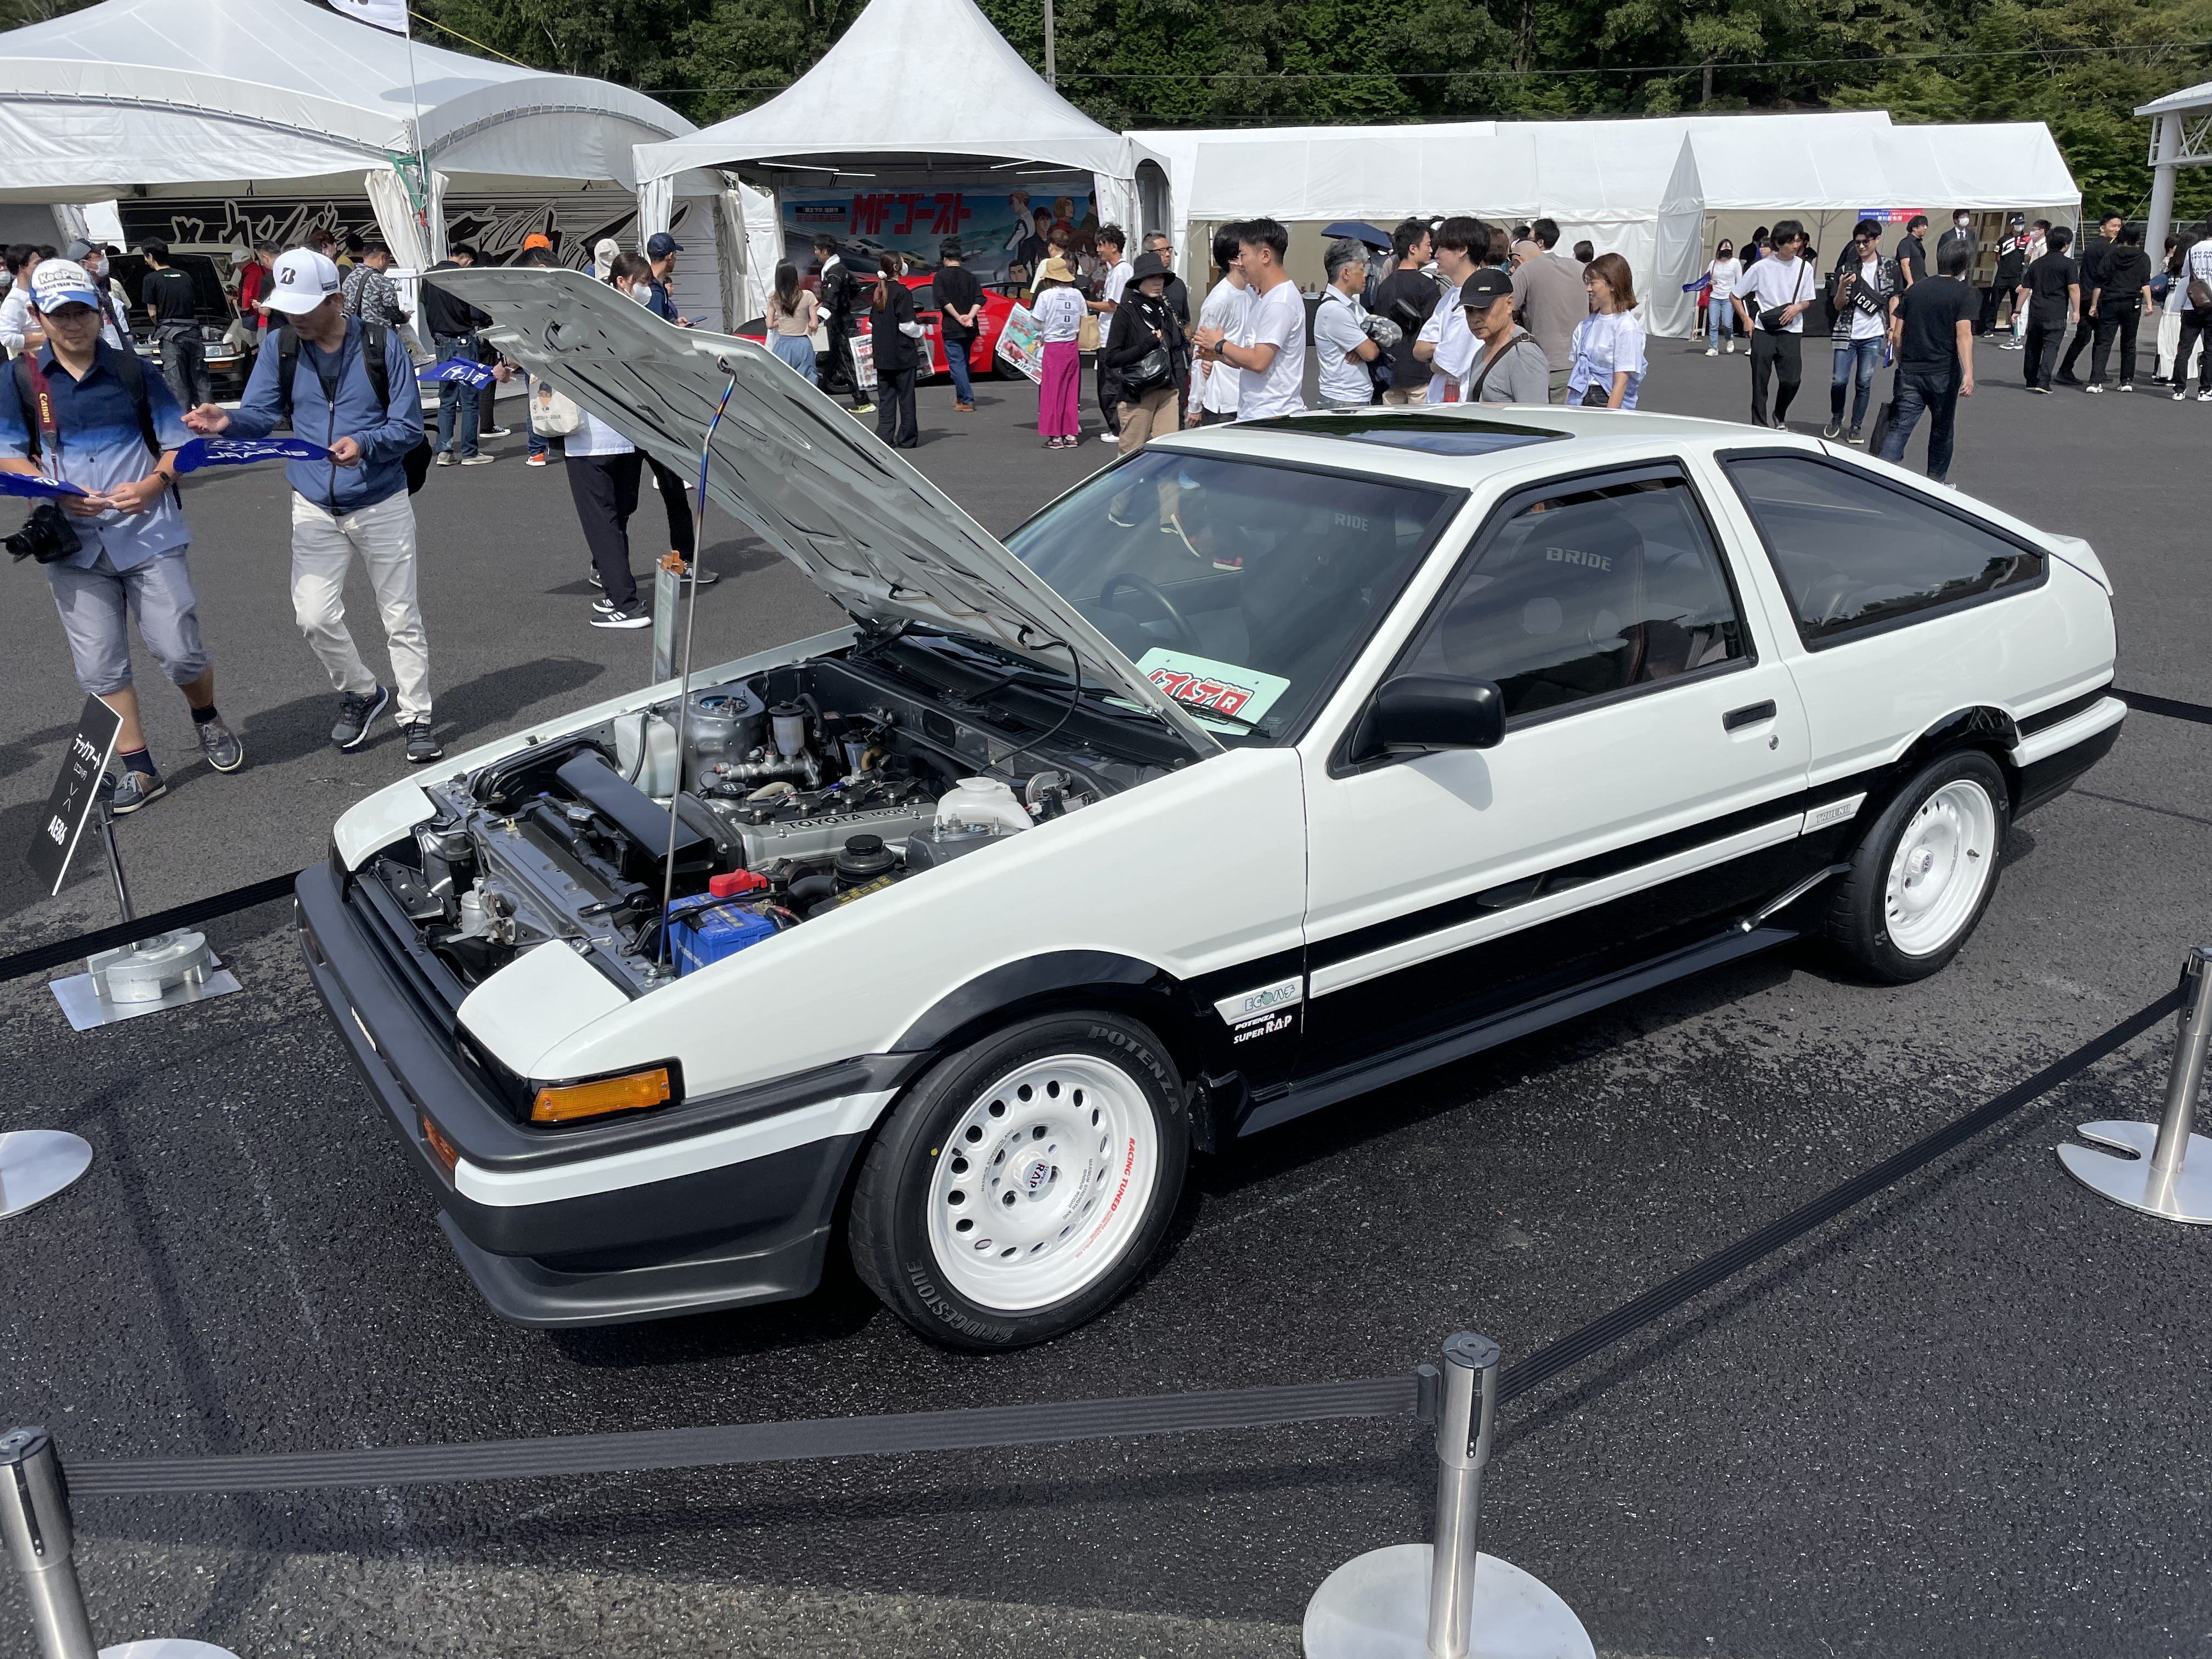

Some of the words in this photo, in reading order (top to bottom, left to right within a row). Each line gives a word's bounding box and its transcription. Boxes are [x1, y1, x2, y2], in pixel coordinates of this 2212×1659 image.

[850, 193, 972, 235] MFゴースト
[1854, 292, 1877, 313] ICON
[1014, 359, 1034, 374] 2023
[39, 393, 51, 423] Canon
[1545, 546, 1612, 572] BRIDE
[73, 733, 103, 770] テックアート
[47, 814, 68, 846] AE86
[785, 814, 866, 830] TOYOTA
[870, 808, 907, 817] 1600
[1234, 1013, 1275, 1031] POTENZA
[1233, 1028, 1265, 1044] SUPER
[1087, 1025, 1180, 1115] POTENZA
[1124, 1137, 1136, 1176] RACING
[1068, 1191, 1080, 1209] WEIGHT
[1071, 1184, 1088, 1210] STRENGTH
[1111, 1178, 1128, 1212] TUNED
[1063, 1210, 1072, 1220] AND
[906, 1259, 1017, 1344] BRIDGESTONE
